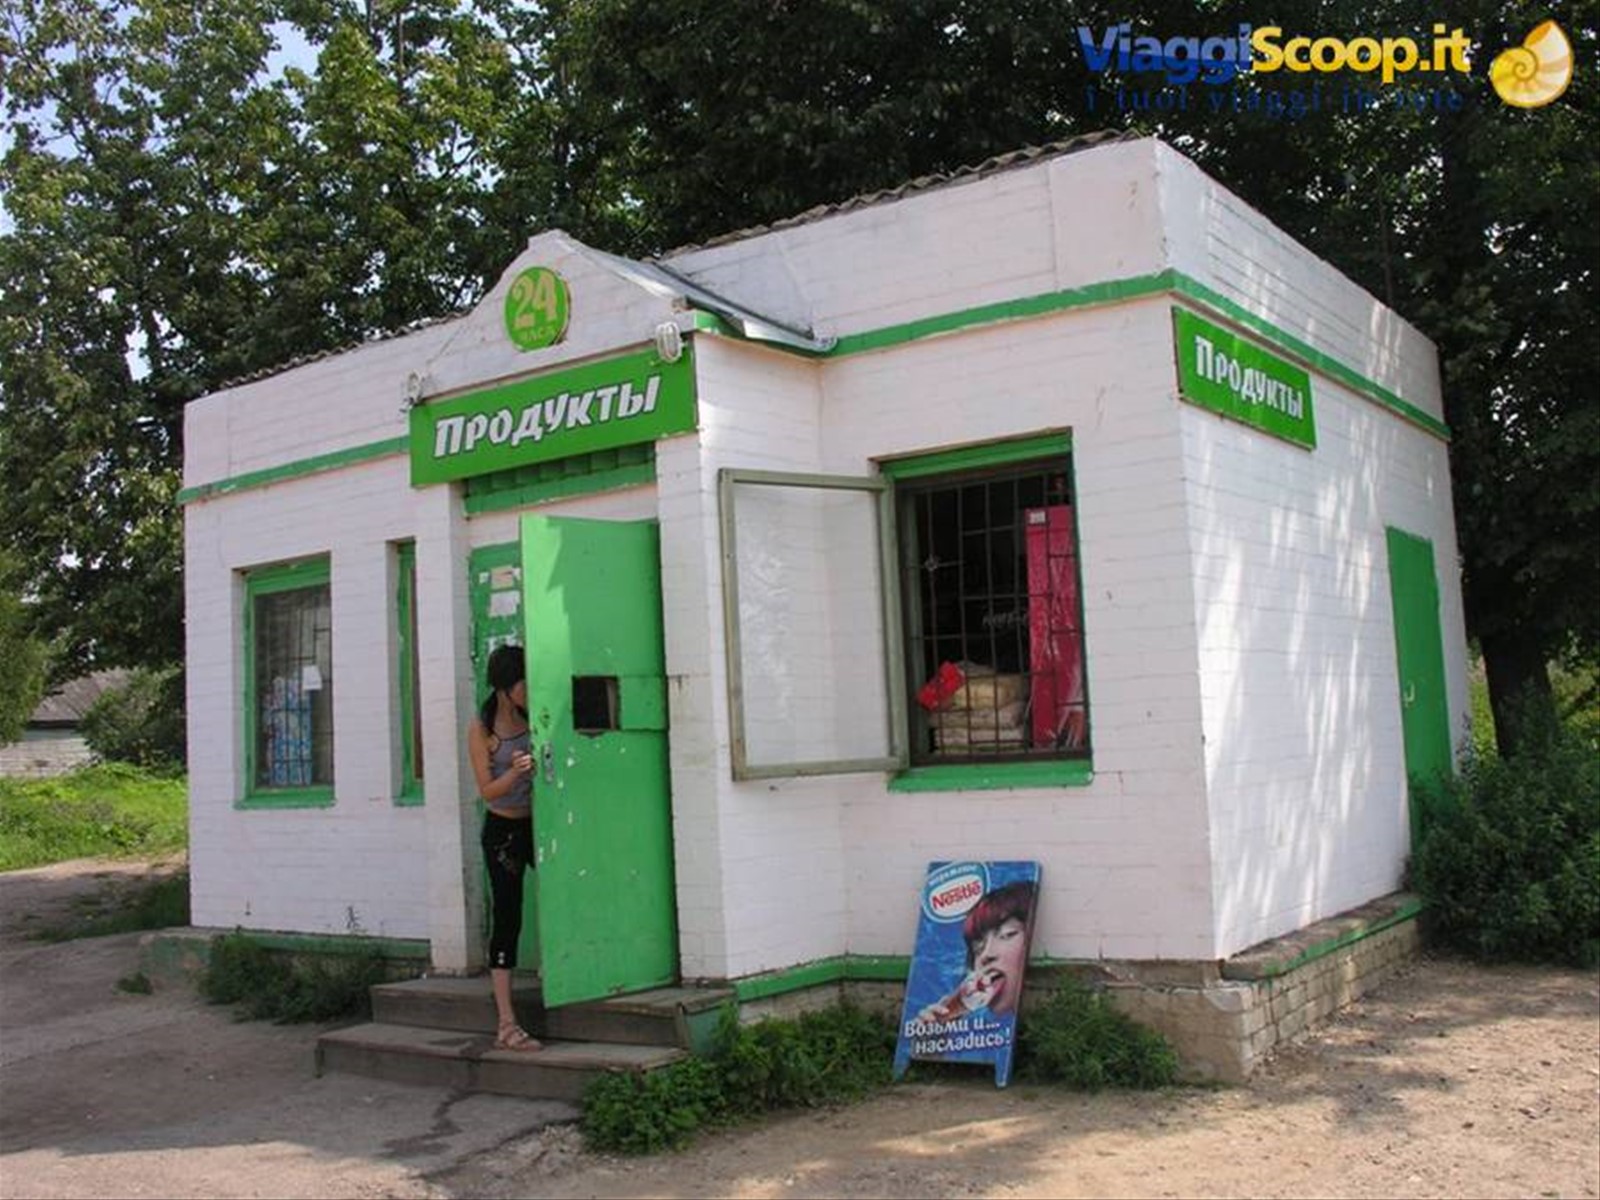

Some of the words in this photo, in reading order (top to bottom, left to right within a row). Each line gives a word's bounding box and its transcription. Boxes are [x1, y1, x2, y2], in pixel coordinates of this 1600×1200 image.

[511, 270, 557, 329] 24
[1194, 334, 1304, 419] ПРОДУКТЫ
[433, 375, 661, 458] ПРОДУКТЫ
[905, 1019, 969, 1038] Возьми
[915, 1027, 1011, 1054] насладись!
